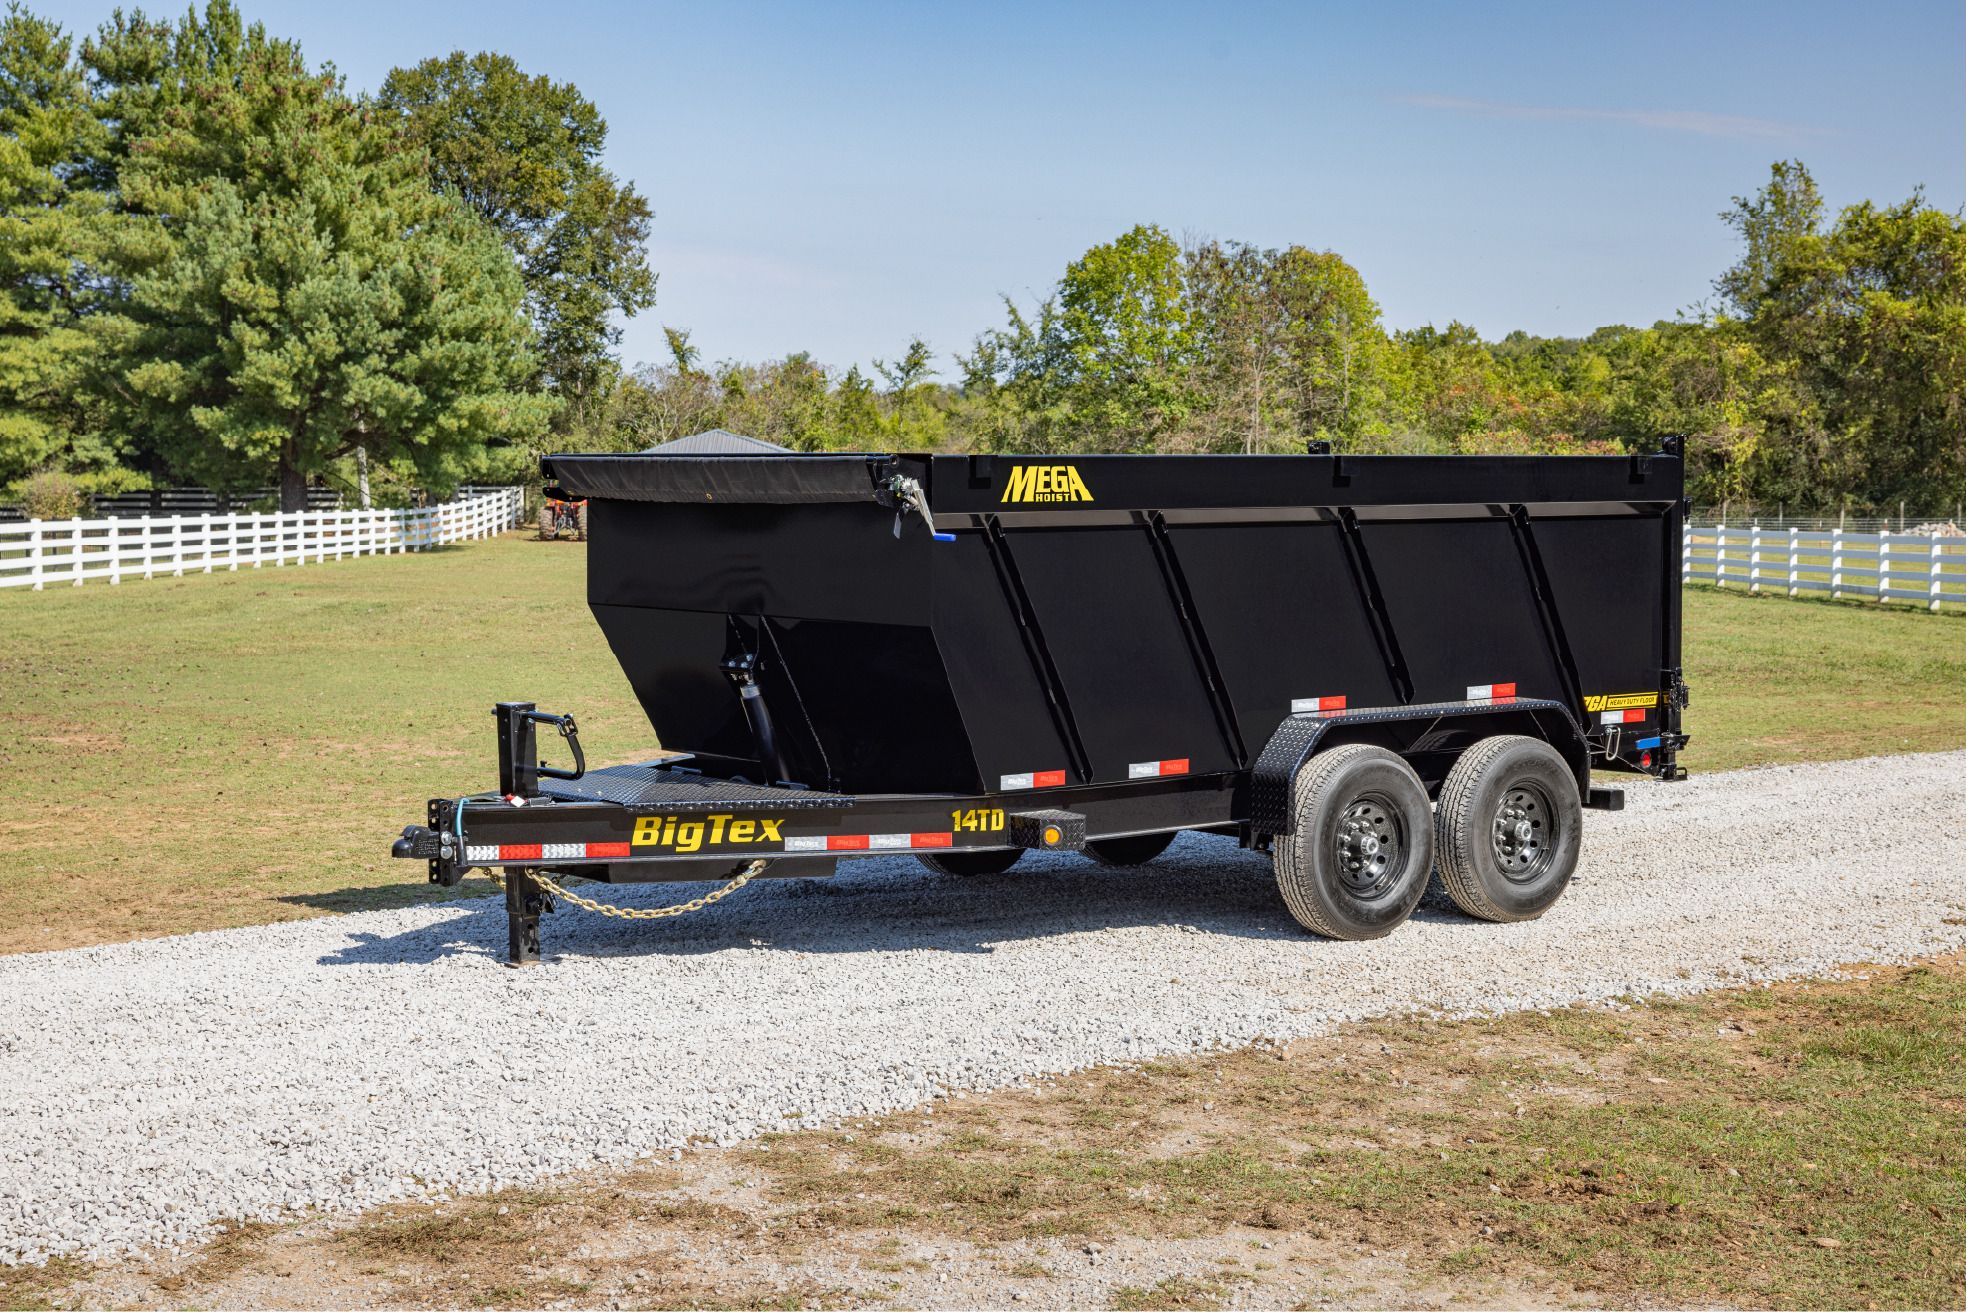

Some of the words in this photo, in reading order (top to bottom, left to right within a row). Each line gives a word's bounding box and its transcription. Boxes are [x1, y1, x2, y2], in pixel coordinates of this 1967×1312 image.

[1000, 465, 1095, 503] MEGA
[1035, 493, 1070, 502] HOIST
[631, 814, 786, 852] BigTex
[951, 808, 1005, 832] 14TD
